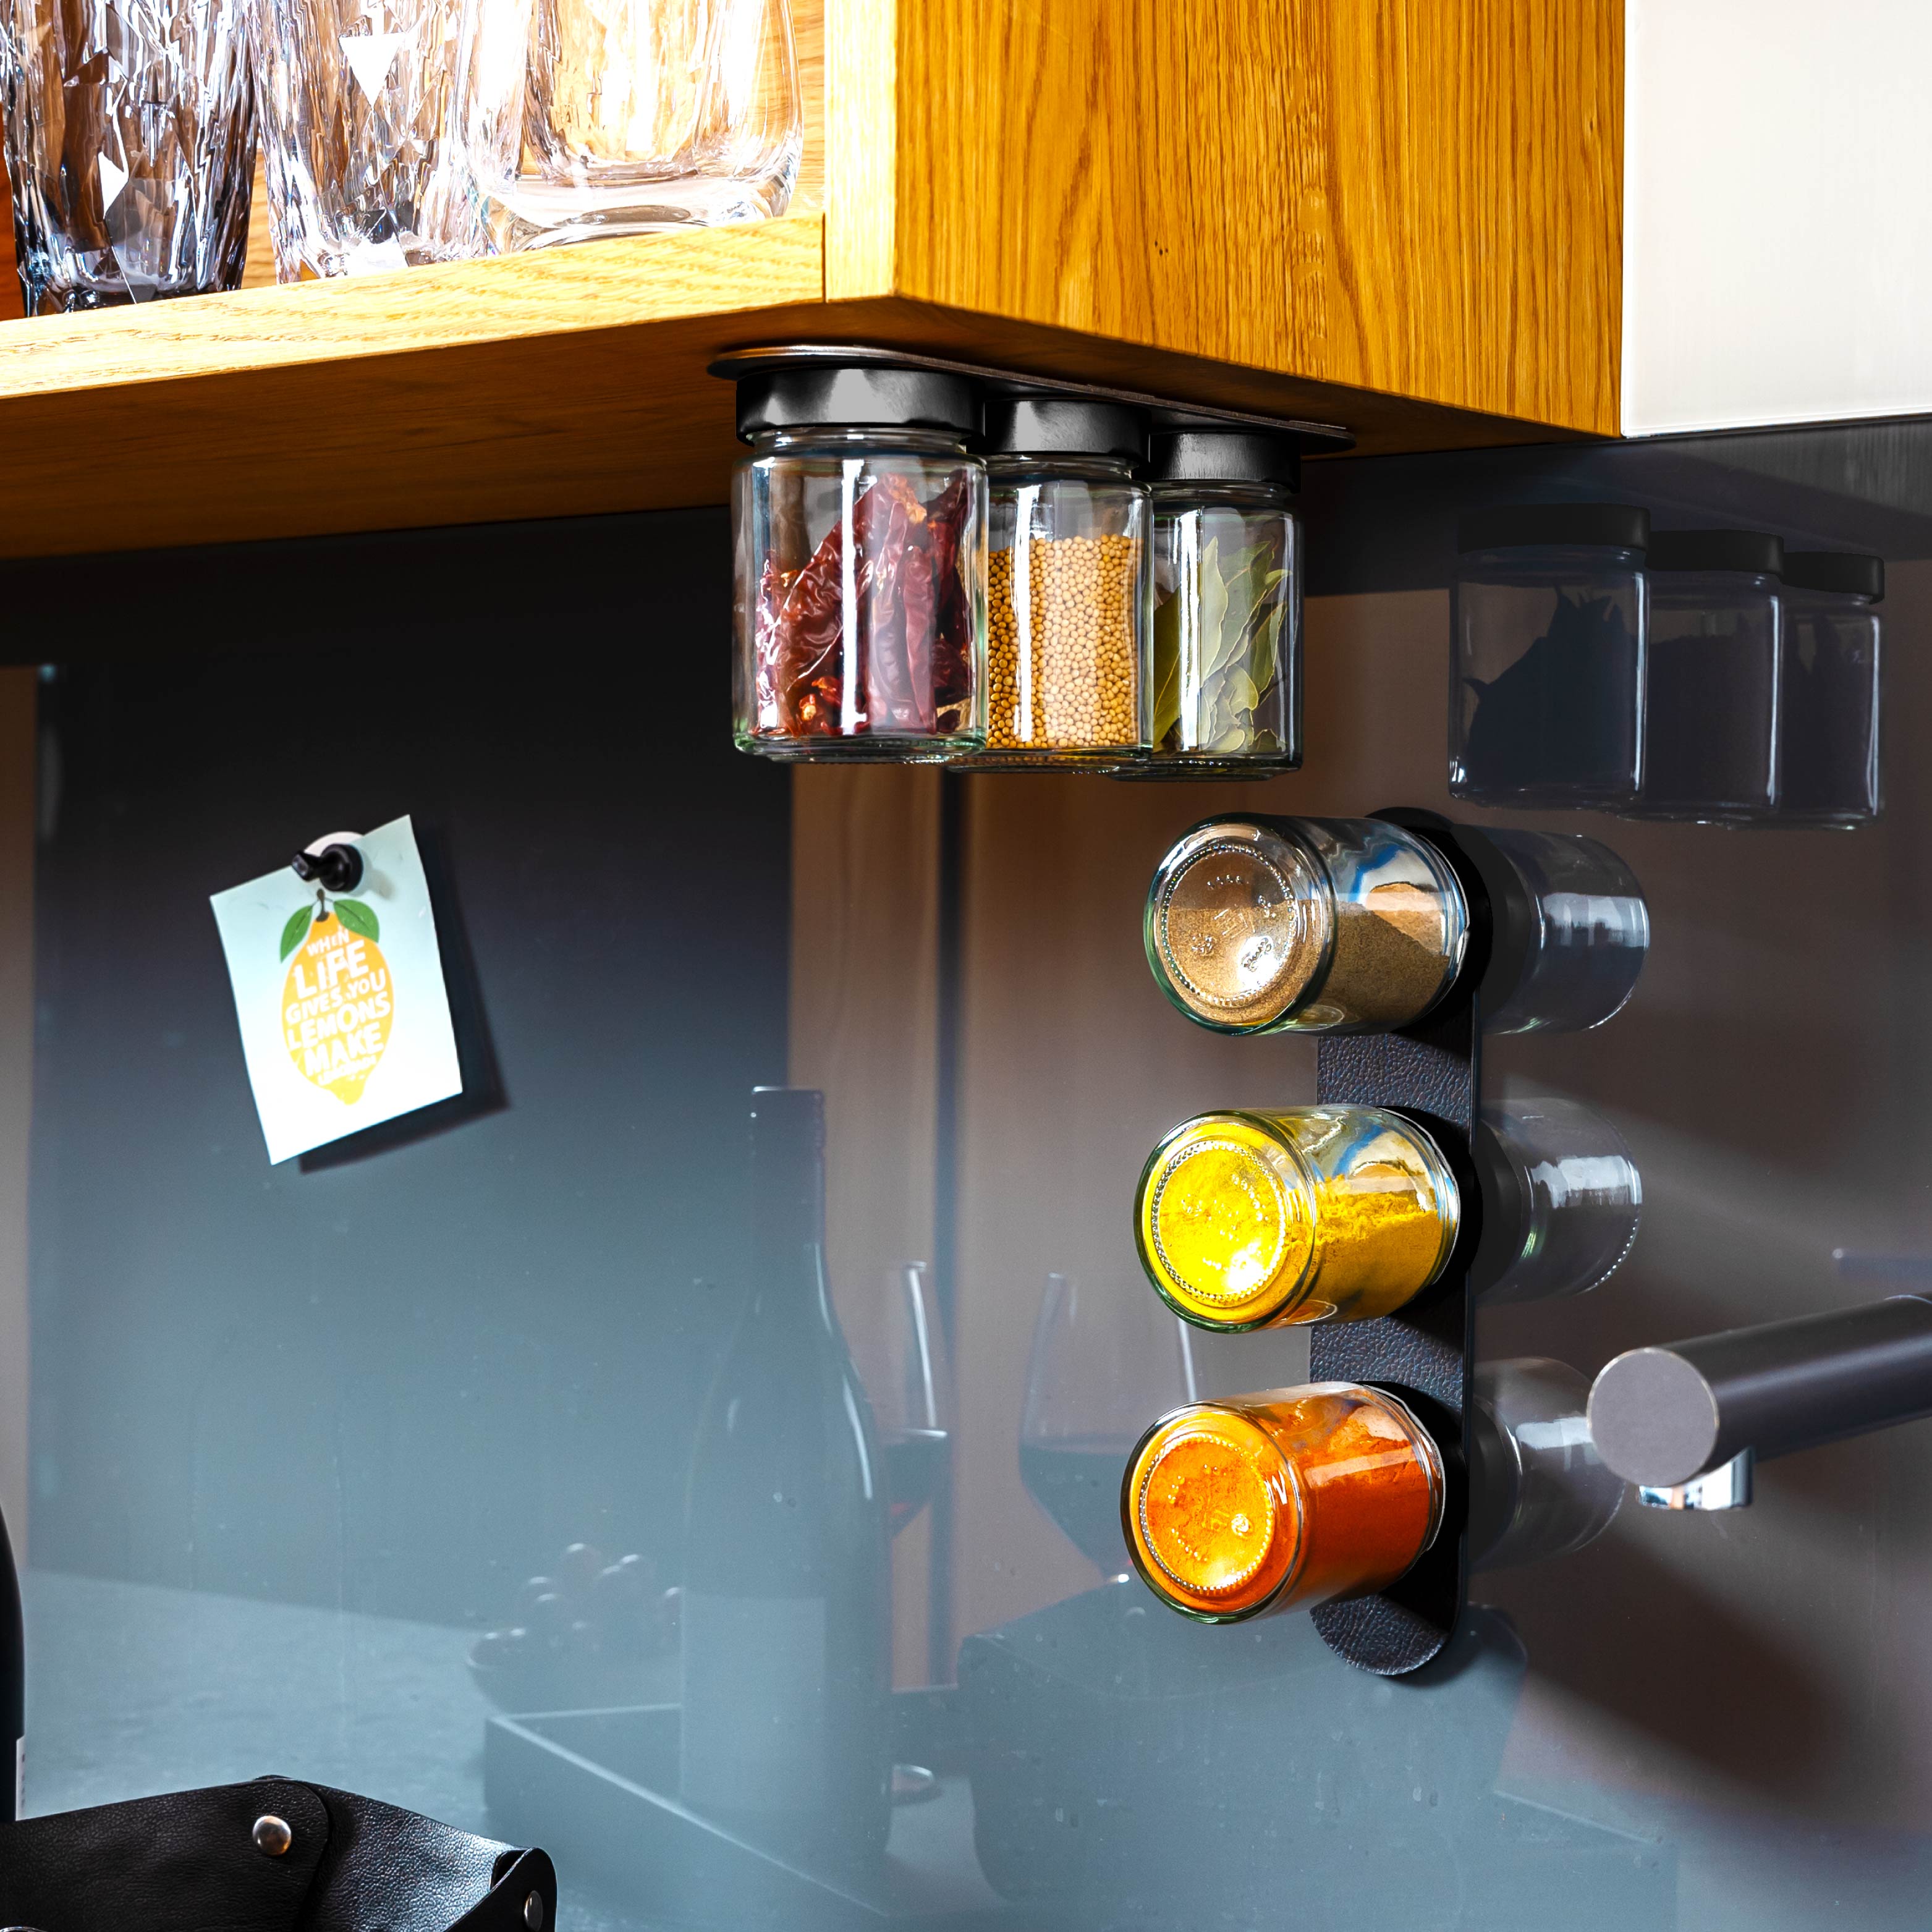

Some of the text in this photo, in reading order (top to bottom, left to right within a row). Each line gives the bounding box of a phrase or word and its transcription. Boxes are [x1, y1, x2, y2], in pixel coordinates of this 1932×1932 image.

[286, 968, 386, 1025] GIVES YOU
[294, 940, 369, 999] LIFE
[287, 991, 391, 1051] LEMONS
[303, 1022, 384, 1077] MAKE
